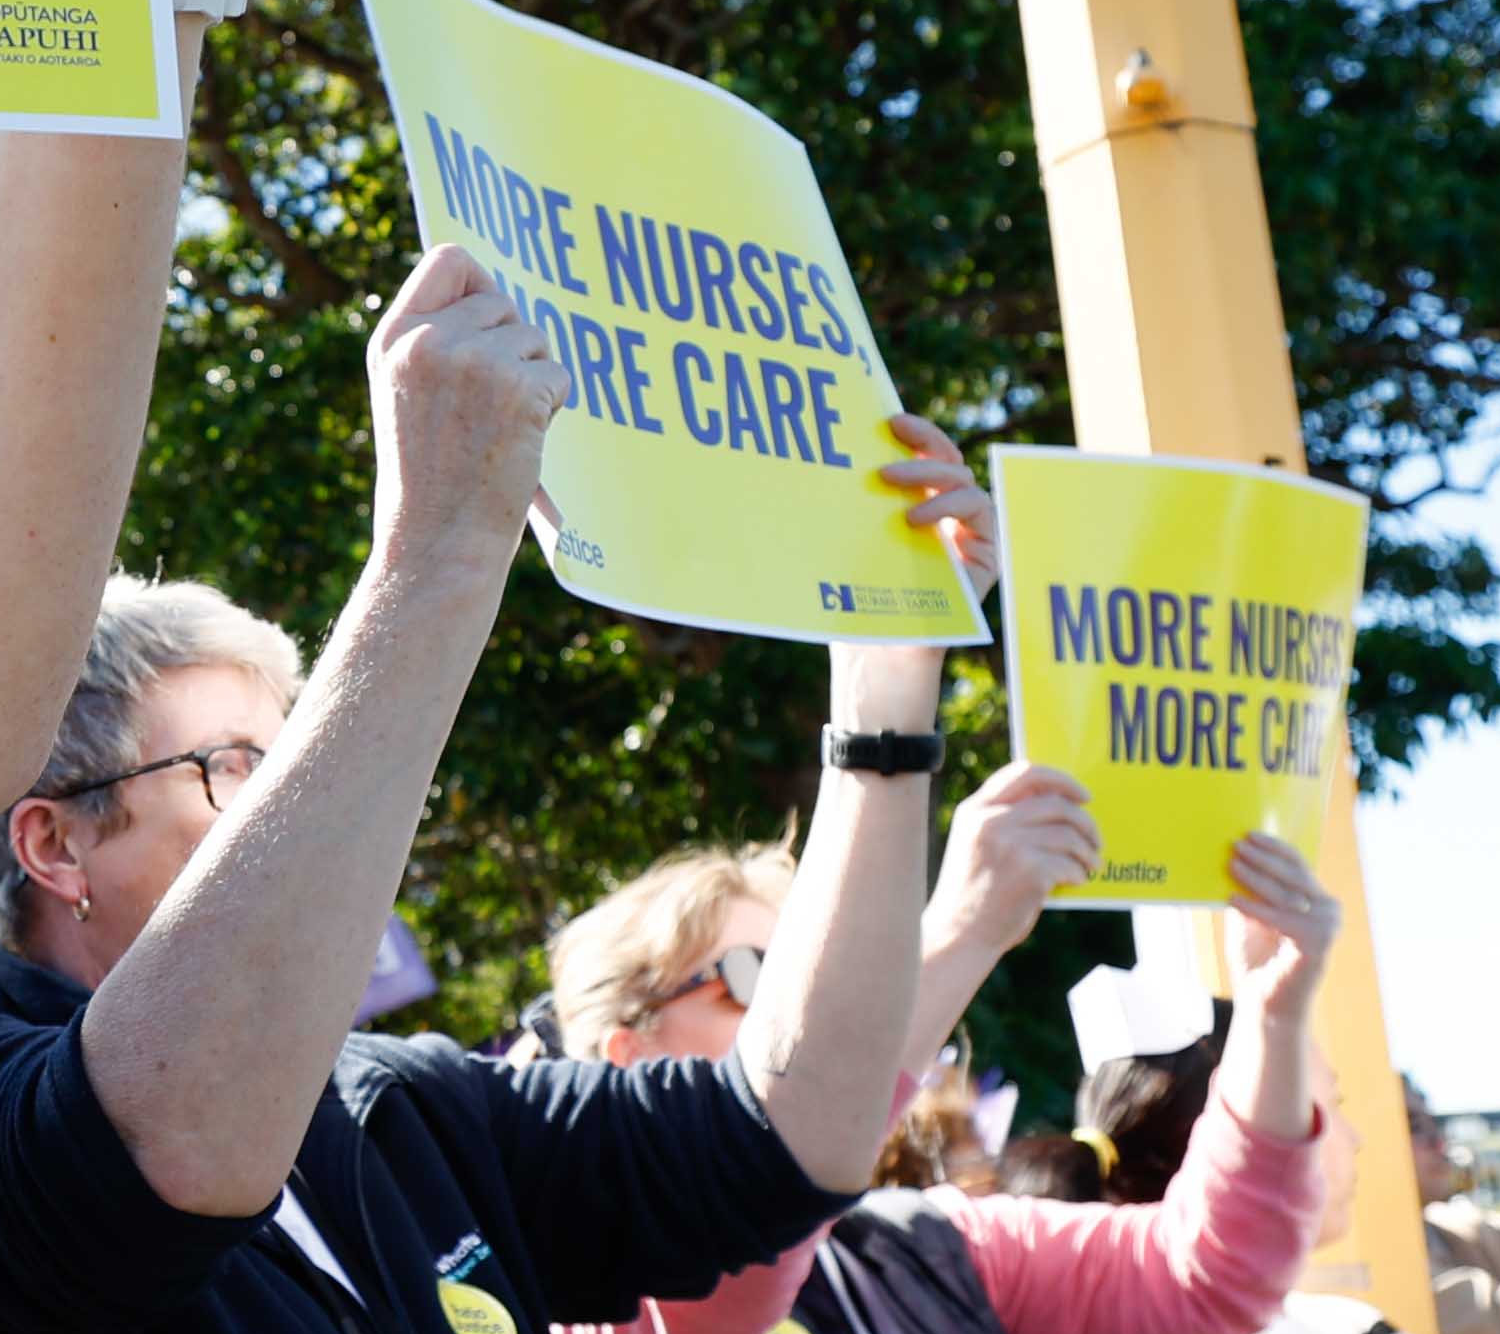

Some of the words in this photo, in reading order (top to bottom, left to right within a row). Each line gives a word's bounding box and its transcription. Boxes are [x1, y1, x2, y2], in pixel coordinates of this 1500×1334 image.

[424, 111, 589, 296] MORE
[595, 203, 873, 377] NURSES,
[672, 341, 853, 469] CARE
[556, 529, 605, 569] stice
[1049, 584, 1213, 673] MORE
[1109, 683, 1247, 770] MORE
[1102, 861, 1167, 884] Justice
